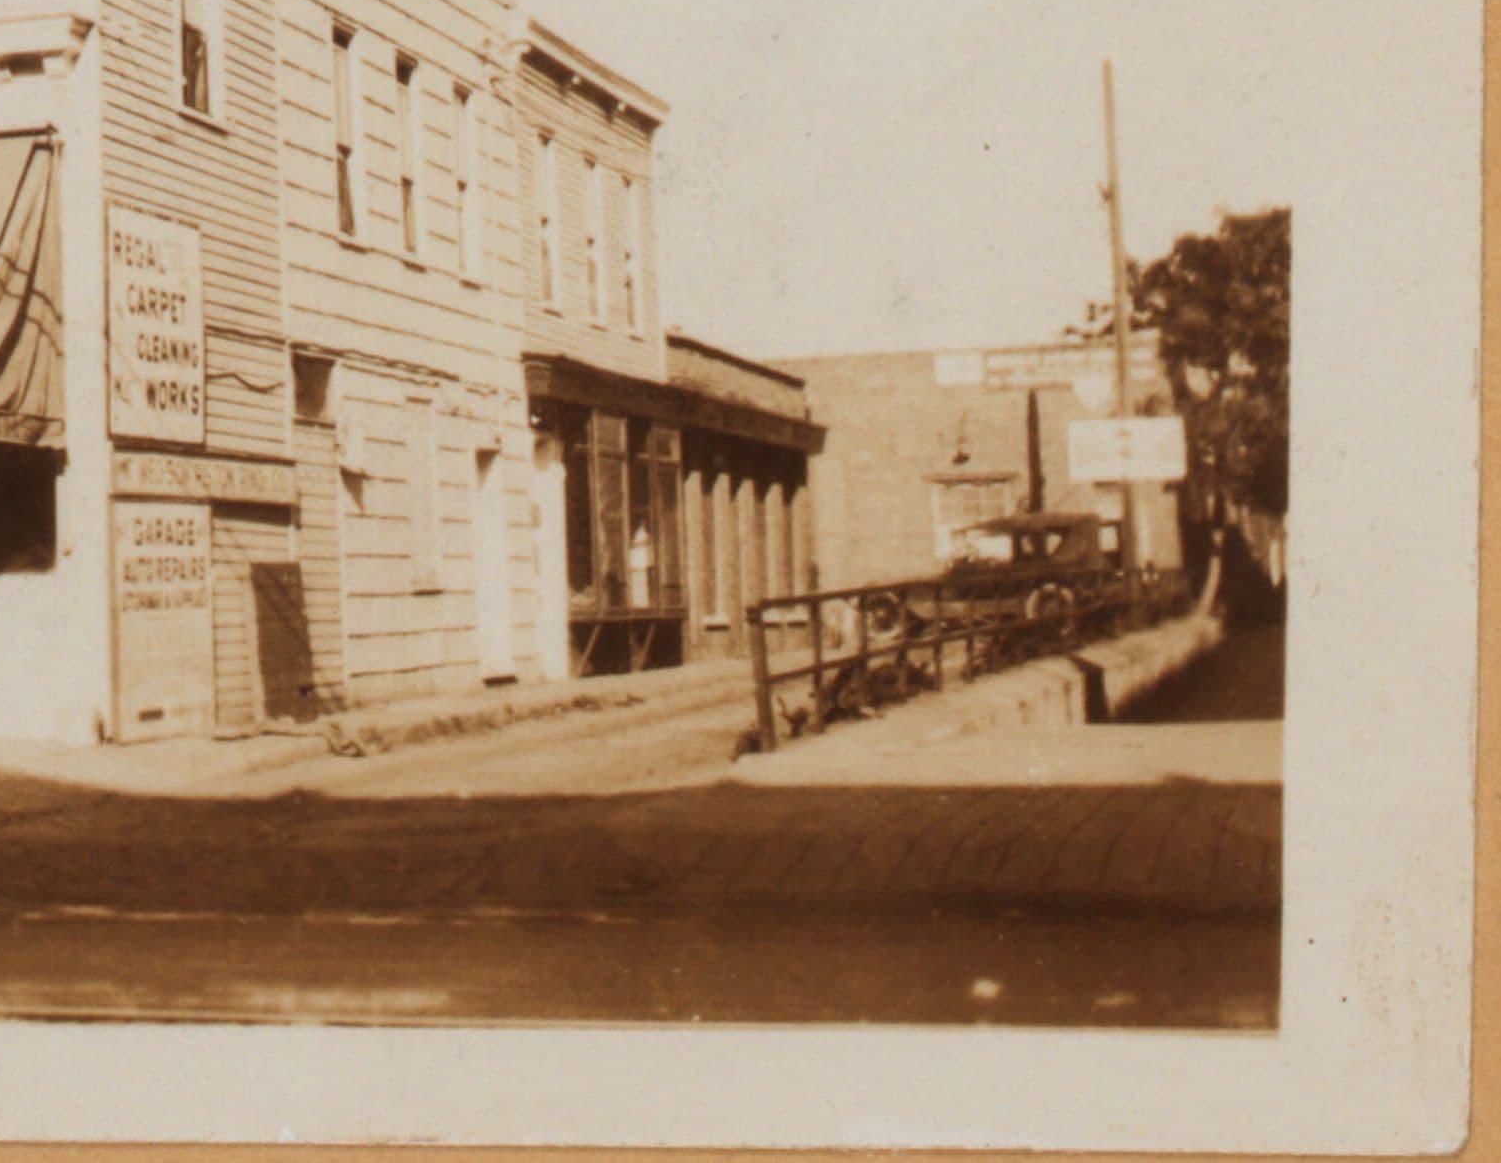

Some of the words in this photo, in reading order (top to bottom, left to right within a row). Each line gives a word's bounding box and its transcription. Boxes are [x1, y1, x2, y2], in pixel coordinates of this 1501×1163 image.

[112, 230, 167, 275] REGAL
[125, 282, 187, 324] CARPET
[146, 379, 200, 417] WORKS
